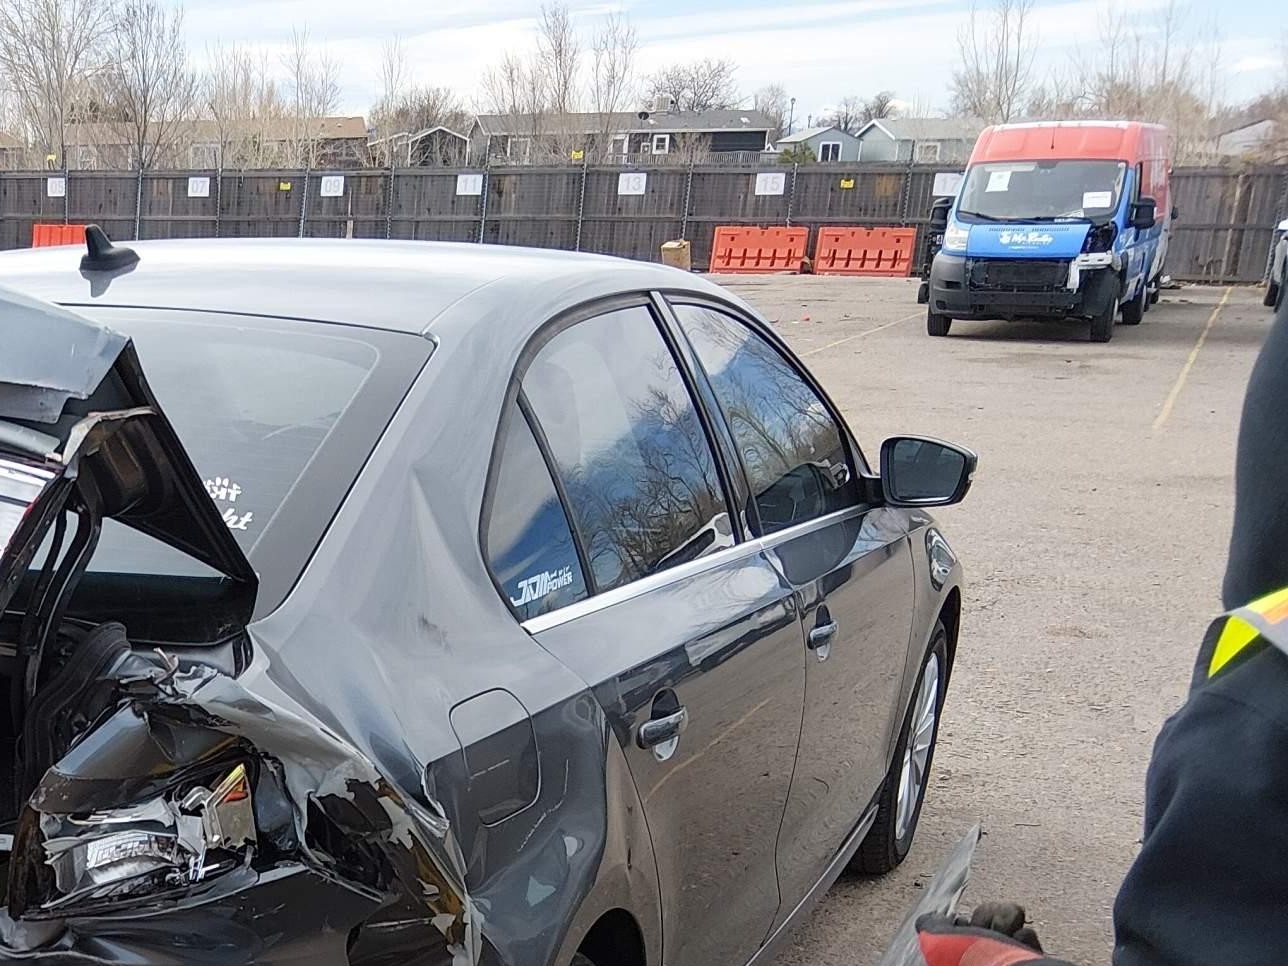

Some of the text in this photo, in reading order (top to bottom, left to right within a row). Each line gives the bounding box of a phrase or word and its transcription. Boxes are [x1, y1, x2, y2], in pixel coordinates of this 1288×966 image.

[49, 180, 64, 194] 05
[191, 180, 209, 194] 07
[324, 179, 341, 194] 09
[462, 177, 478, 193] 11
[623, 176, 642, 192] 13
[761, 175, 781, 192] 15
[547, 570, 573, 594] POWER
